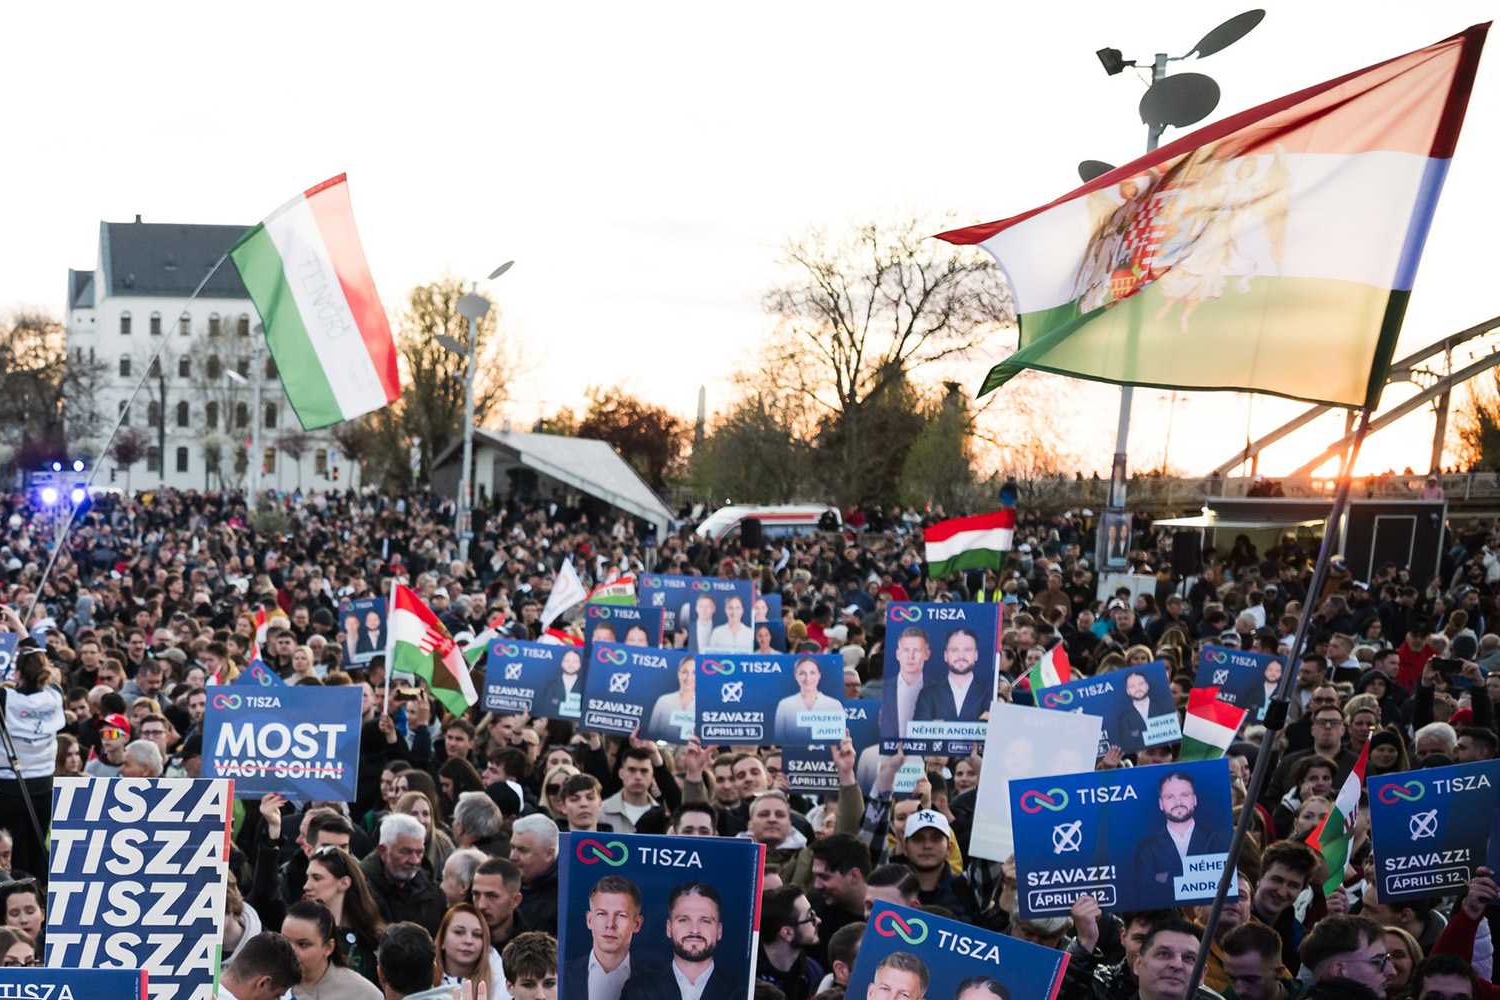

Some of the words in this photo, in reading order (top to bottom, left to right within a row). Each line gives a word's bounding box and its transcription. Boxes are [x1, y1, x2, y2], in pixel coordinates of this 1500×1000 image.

[614, 610, 641, 620] TISZA
[927, 608, 966, 620] TISZA
[522, 647, 553, 660] TISZA
[632, 654, 668, 669] TISZA
[1231, 655, 1258, 668] TISZA
[741, 662, 781, 673] TISZA
[488, 685, 535, 698] SZAVAZZ!
[1077, 681, 1114, 698] TISZA
[246, 696, 281, 708] TISZA
[589, 699, 643, 716] SZAVAZZ!
[590, 713, 622, 727] ÁPRILIS
[624, 719, 635, 729] 12.
[702, 712, 764, 723] SZAVAZZ!
[706, 725, 744, 737] ÁPRILIS
[746, 727, 758, 737] 12.
[816, 727, 842, 735] JUDIT
[912, 725, 944, 735] NÉHER
[948, 726, 987, 737] ANDRÁS
[215, 722, 347, 759] MOST
[214, 759, 271, 778] VAGY
[274, 760, 343, 780] SOHA!
[791, 774, 827, 786] ÁPRILIS
[1433, 774, 1491, 794] TISZA
[53, 777, 228, 823] TISZA
[1077, 785, 1138, 805] TISZA
[50, 828, 225, 875] TISZA
[638, 847, 702, 868] TISZA
[1385, 849, 1470, 871] SZAVAZZ!
[1027, 865, 1116, 886] SZAVAZZ!
[1393, 873, 1443, 889] ÁPRILIS
[1447, 872, 1464, 883] 12.
[48, 880, 218, 927] TISZA
[46, 932, 214, 976] TISZA
[938, 929, 1001, 965] TISZA
